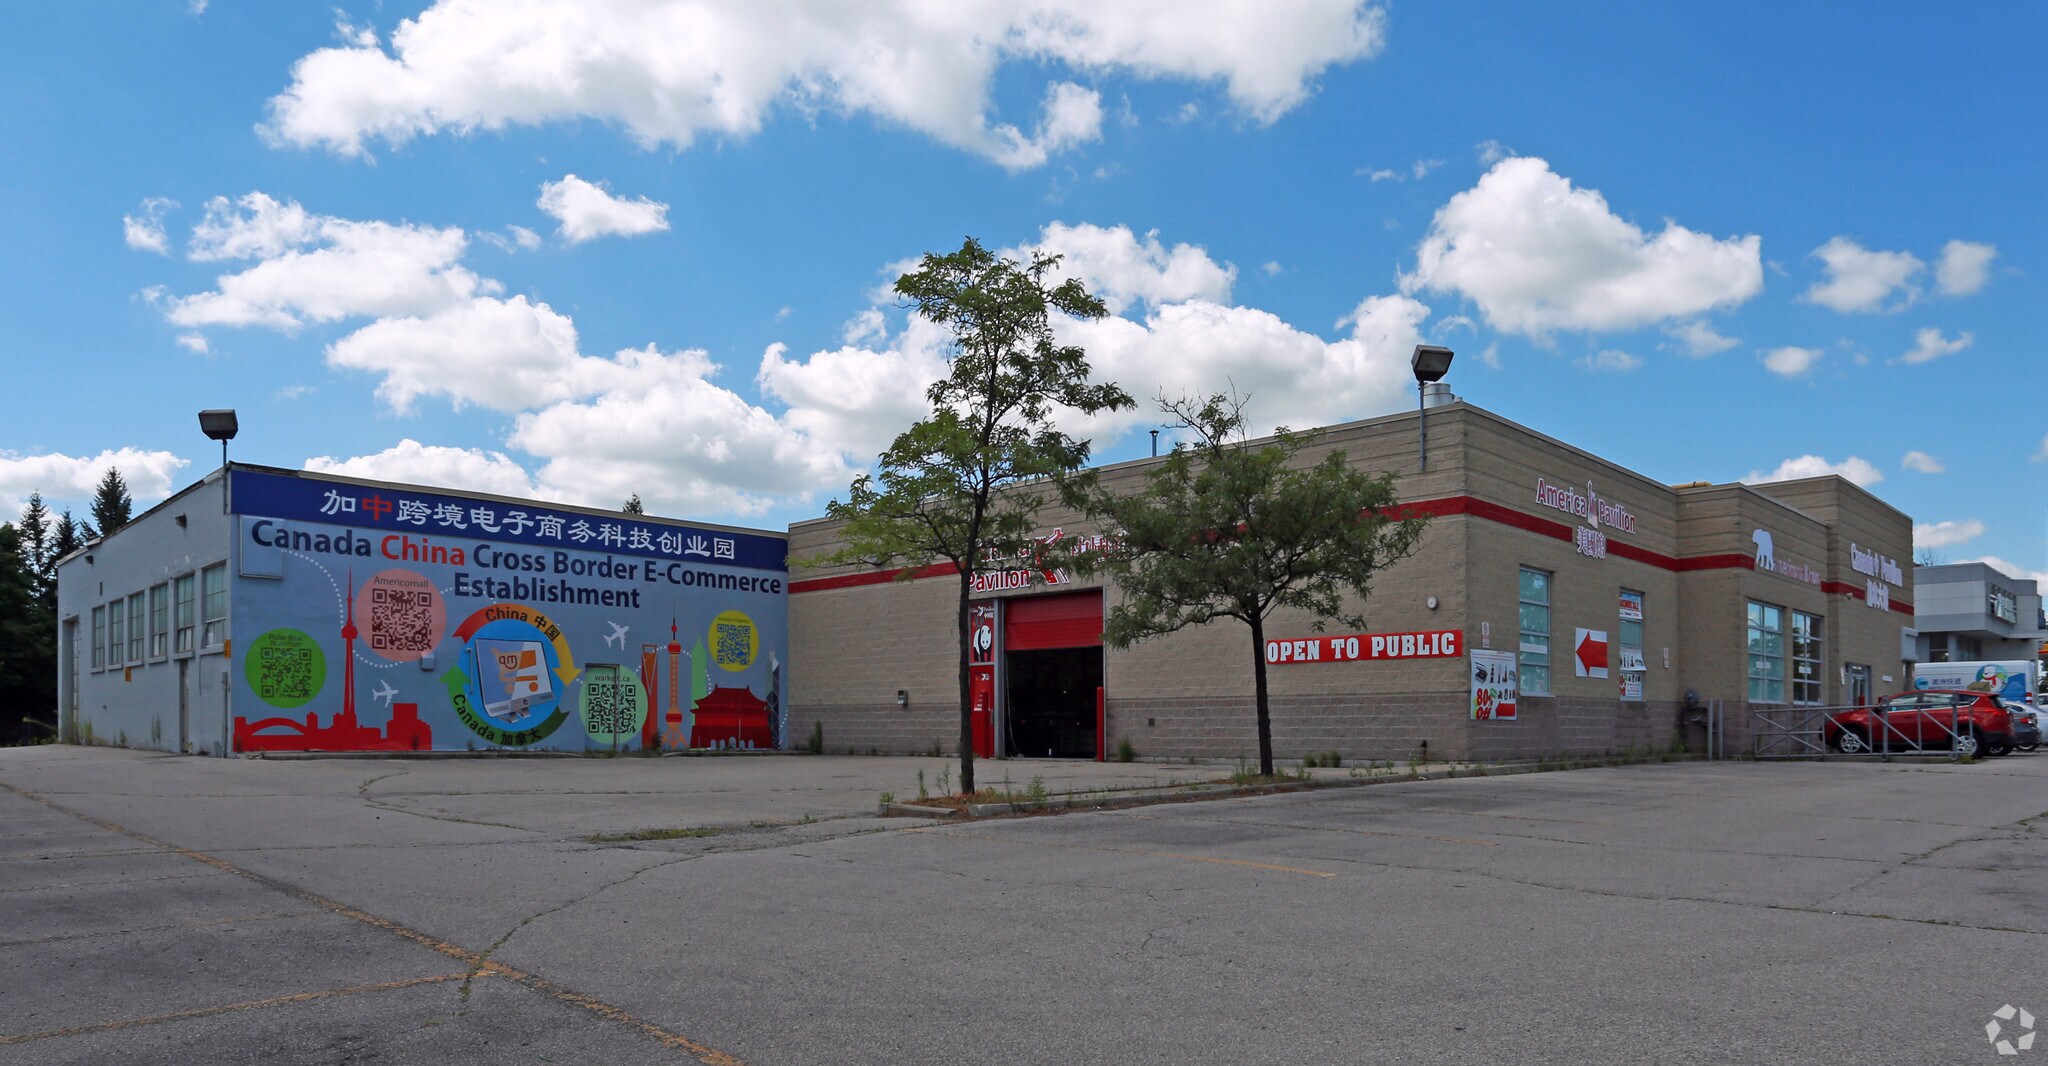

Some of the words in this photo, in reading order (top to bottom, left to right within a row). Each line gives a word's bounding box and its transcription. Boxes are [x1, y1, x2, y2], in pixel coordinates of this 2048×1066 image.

[1536, 477, 1587, 518] America
[1598, 498, 1636, 535] Pavilion
[320, 490, 736, 560] 加中跨境电子商务科技创业园
[251, 520, 372, 557] Canada
[381, 535, 465, 566] China
[473, 544, 546, 572] Cross
[553, 551, 637, 580] Border
[644, 560, 782, 594] E-Commerce
[373, 576, 429, 588] Americomall
[454, 572, 640, 609] Establishment
[485, 606, 528, 622] China
[534, 615, 560, 642] 中国
[268, 633, 287, 641] Polar
[288, 634, 303, 642] Bear
[270, 640, 303, 648] Nutrition
[1267, 640, 1320, 662] OPEN
[1331, 637, 1360, 659] TO
[1371, 632, 1455, 657] PUBLIC
[453, 693, 495, 741] Canada
